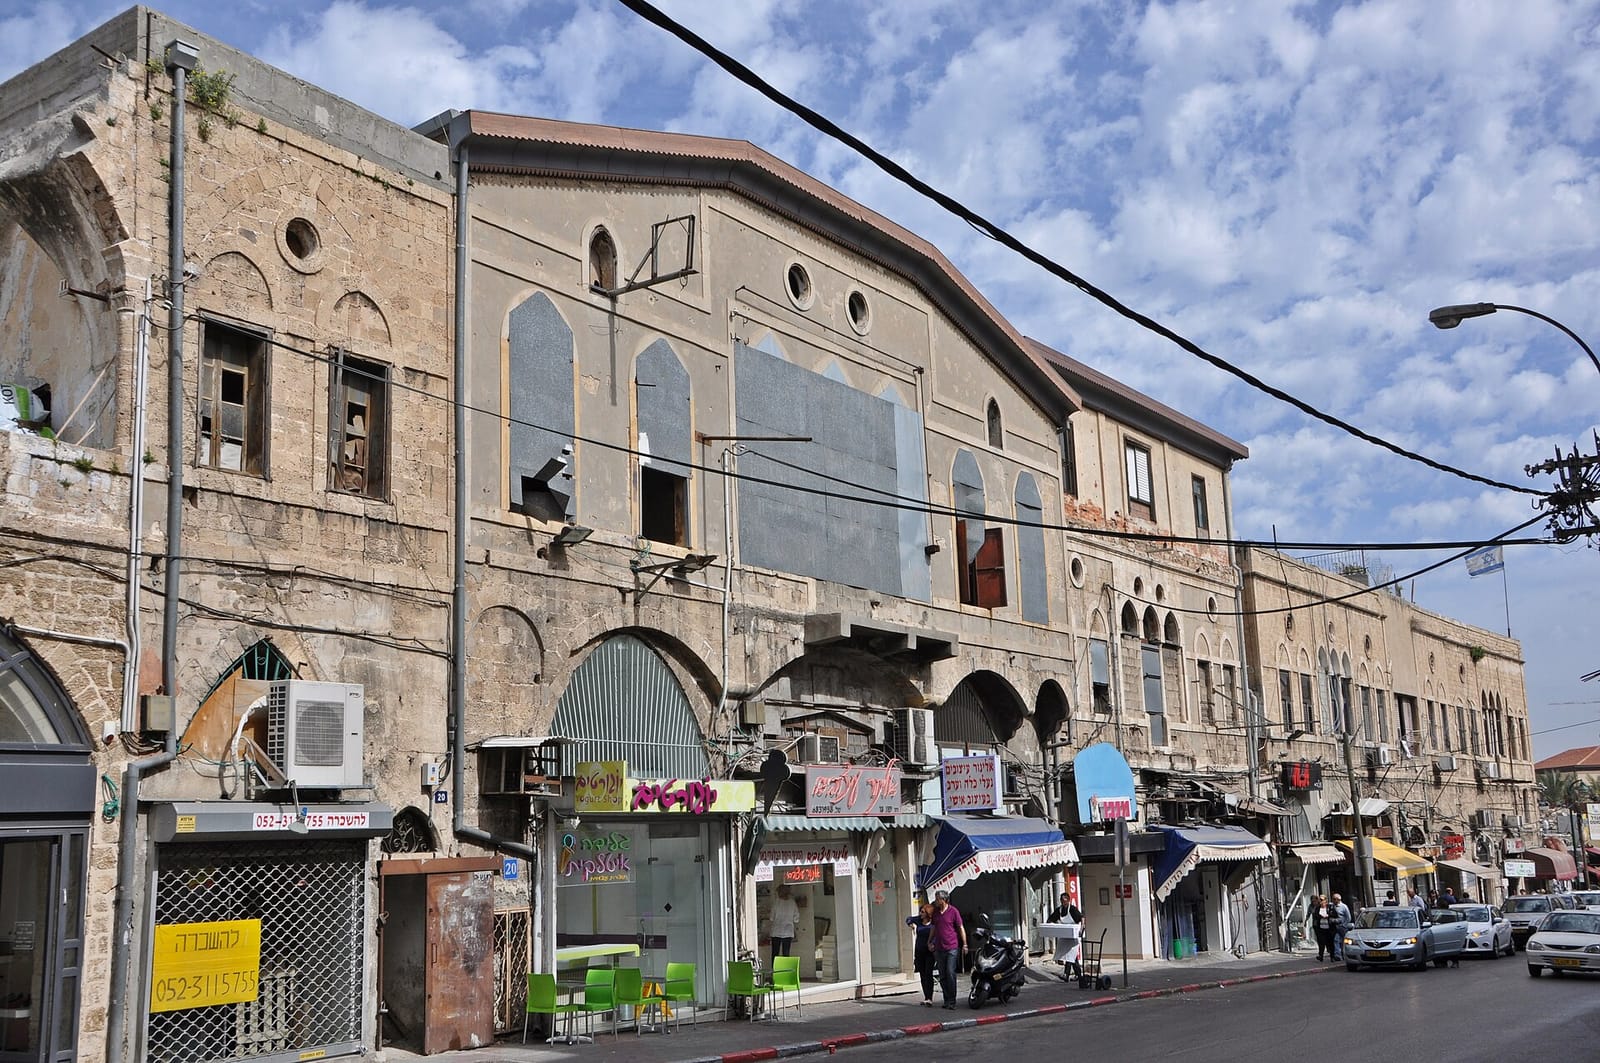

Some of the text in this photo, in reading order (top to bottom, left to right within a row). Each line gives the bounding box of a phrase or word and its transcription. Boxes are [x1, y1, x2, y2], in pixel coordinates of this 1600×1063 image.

[945, 758, 994, 775] אלינור עיצובים
[979, 774, 993, 788] נעלי
[437, 793, 446, 801] 20
[632, 776, 718, 815] יוגורטים
[949, 795, 965, 806] אישי
[256, 813, 367, 828] להשכרה 052-31755
[505, 863, 517, 875] 20
[175, 929, 240, 953] להשכרה
[156, 970, 256, 1002] 052-3115755
